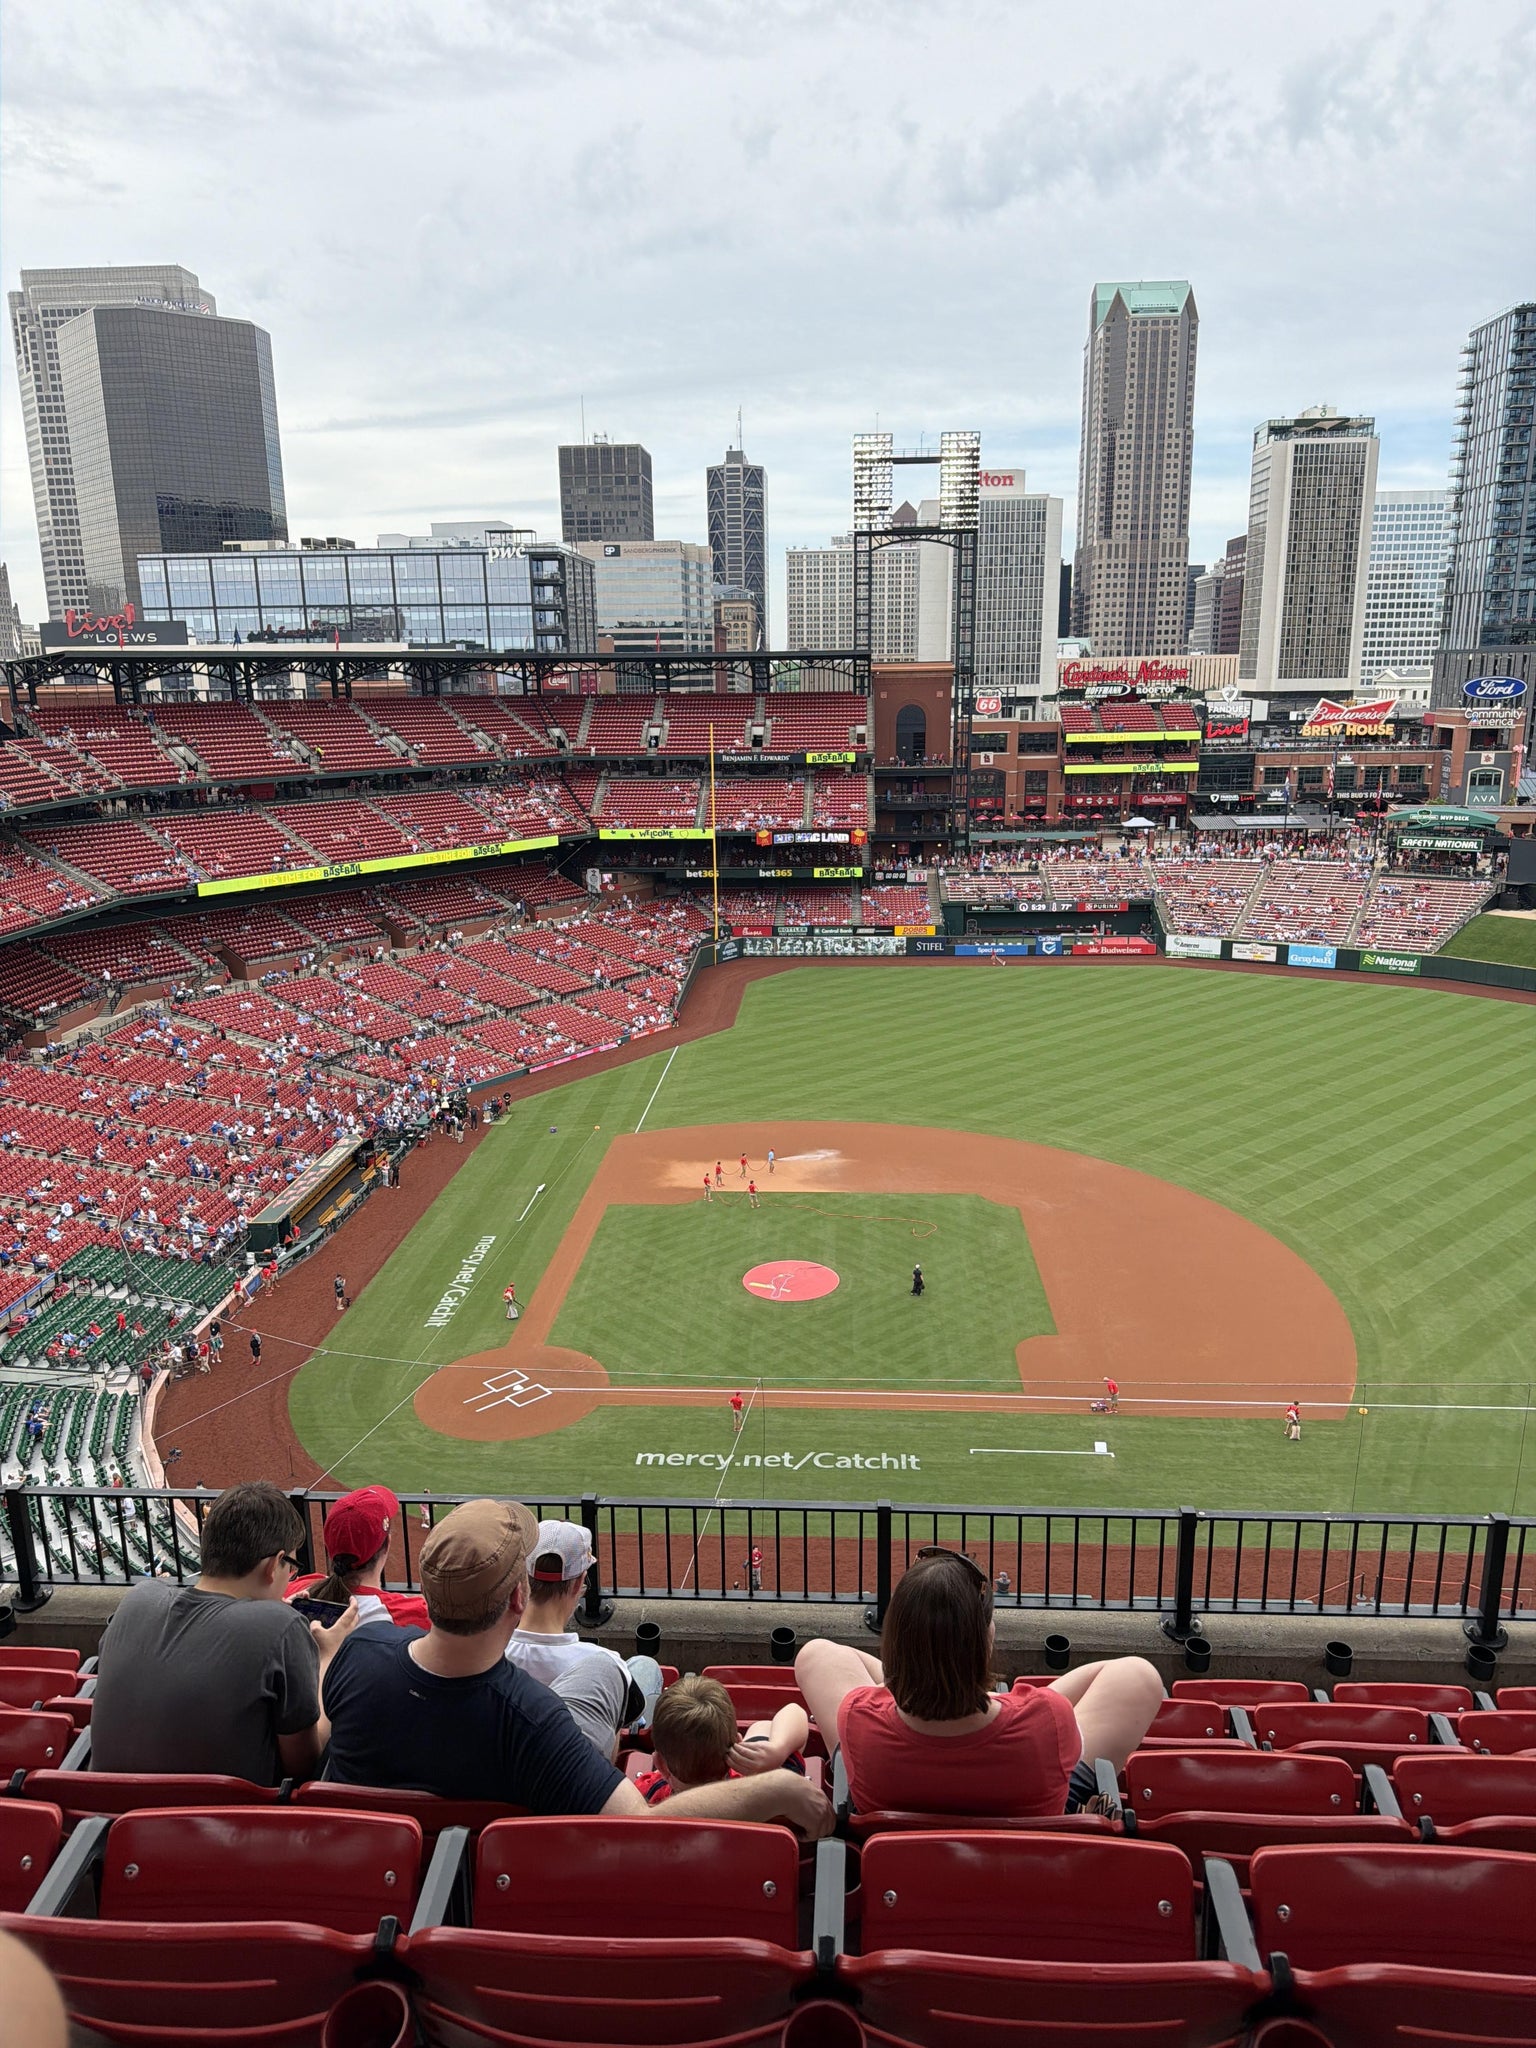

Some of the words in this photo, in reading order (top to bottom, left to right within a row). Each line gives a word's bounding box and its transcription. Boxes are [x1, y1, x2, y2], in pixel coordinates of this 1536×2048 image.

[978, 471, 1014, 487] lton
[487, 545, 527, 564] pwc
[65, 603, 135, 638] Live!
[96, 633, 157, 643] LOEWS
[1063, 661, 1129, 687] Cardinals
[1129, 659, 1188, 686] Nation
[1085, 686, 1123, 695] HOFFMANN
[1136, 686, 1177, 694] ROOFTOP
[1476, 679, 1516, 695] Ford
[980, 699, 997, 710] 66
[1208, 705, 1249, 713] FANDUEL
[1305, 707, 1397, 722] Budweiser
[1464, 709, 1524, 720] Community
[1206, 717, 1249, 739] Live!
[1302, 725, 1343, 736] BREW
[1346, 724, 1395, 736] HOUSE
[811, 753, 850, 762] BASEBALL
[639, 829, 675, 838] WELCOME
[821, 833, 849, 843] LAND
[1401, 838, 1434, 847] SAFETY
[1434, 839, 1479, 849] NATIONAL
[323, 863, 363, 878] BASEBALL
[759, 869, 793, 877] bet365
[819, 868, 858, 877] BASEBALL
[916, 942, 944, 951] STIFEL
[1101, 946, 1142, 954] Budweiser
[1375, 955, 1417, 968] National
[423, 1235, 497, 1328] mercy.net/CatchIt
[635, 1452, 921, 1471] mercy.net/CatchIt
